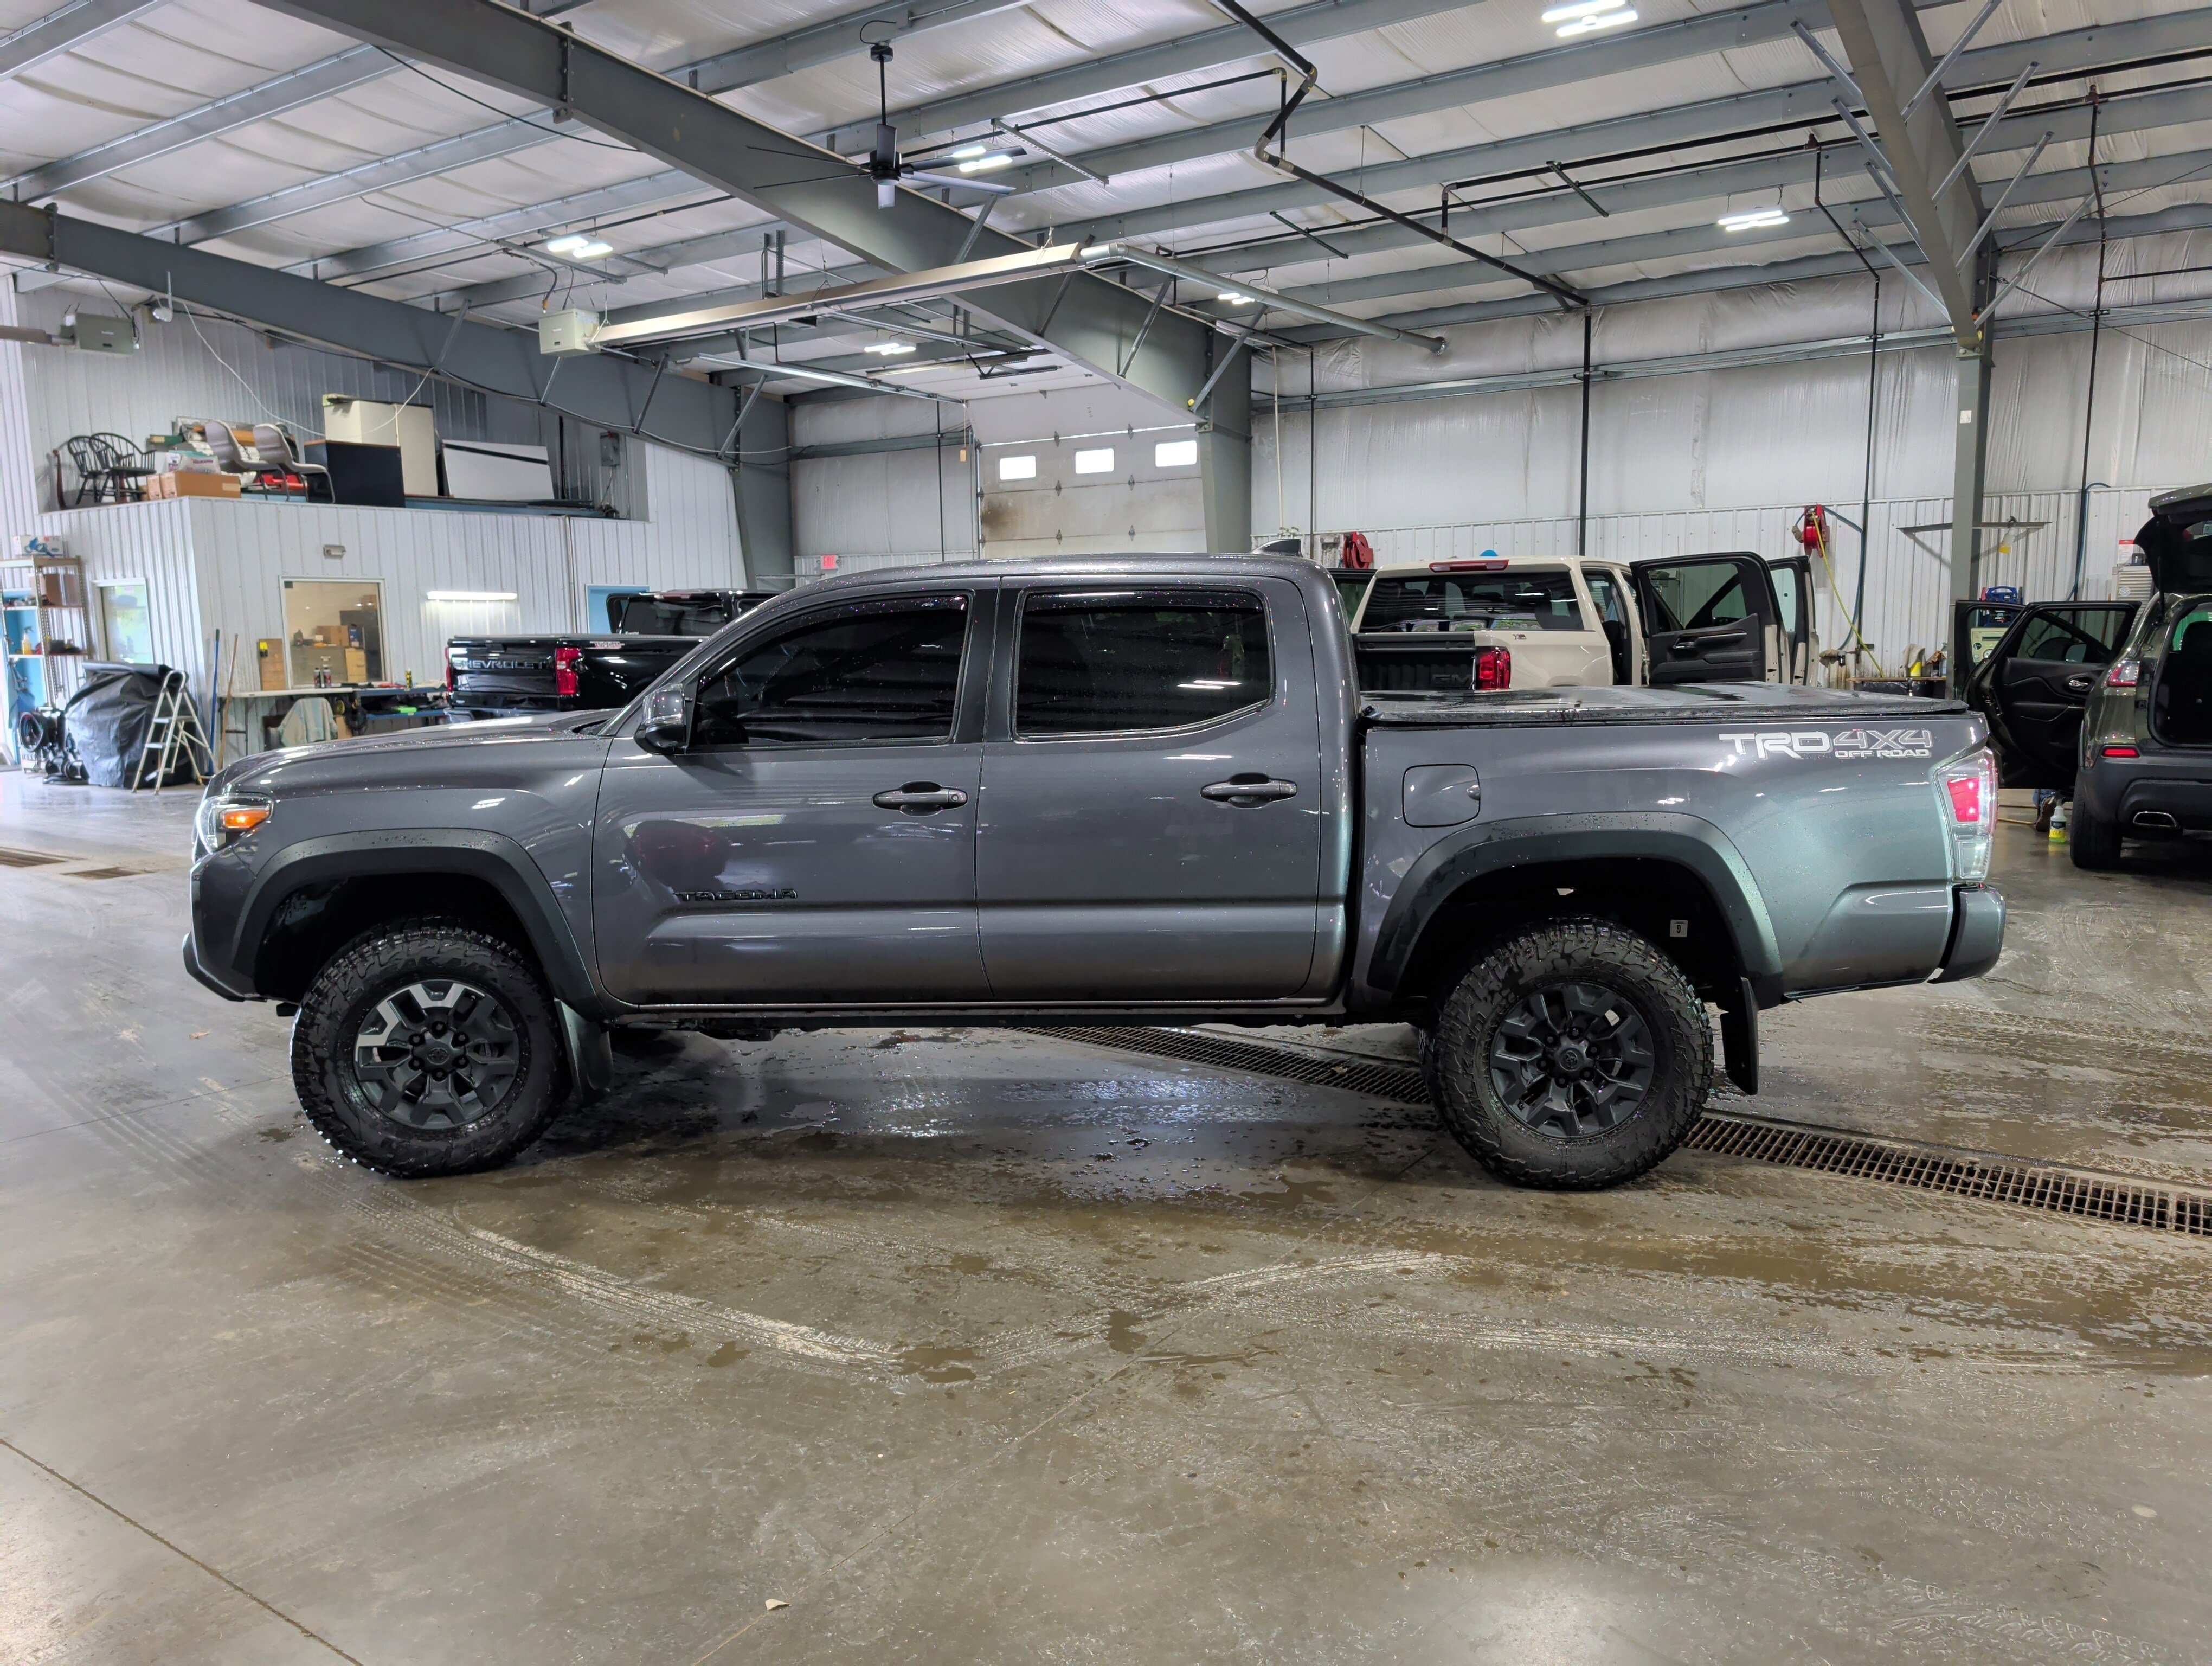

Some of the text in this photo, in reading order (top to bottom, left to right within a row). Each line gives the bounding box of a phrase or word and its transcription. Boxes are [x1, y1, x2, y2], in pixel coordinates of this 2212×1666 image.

[453, 659, 546, 669] CHEVROLET
[1719, 732, 1832, 758] TRD
[1835, 749, 1931, 758] OFF ROAD
[675, 889, 798, 901] TACOMA
